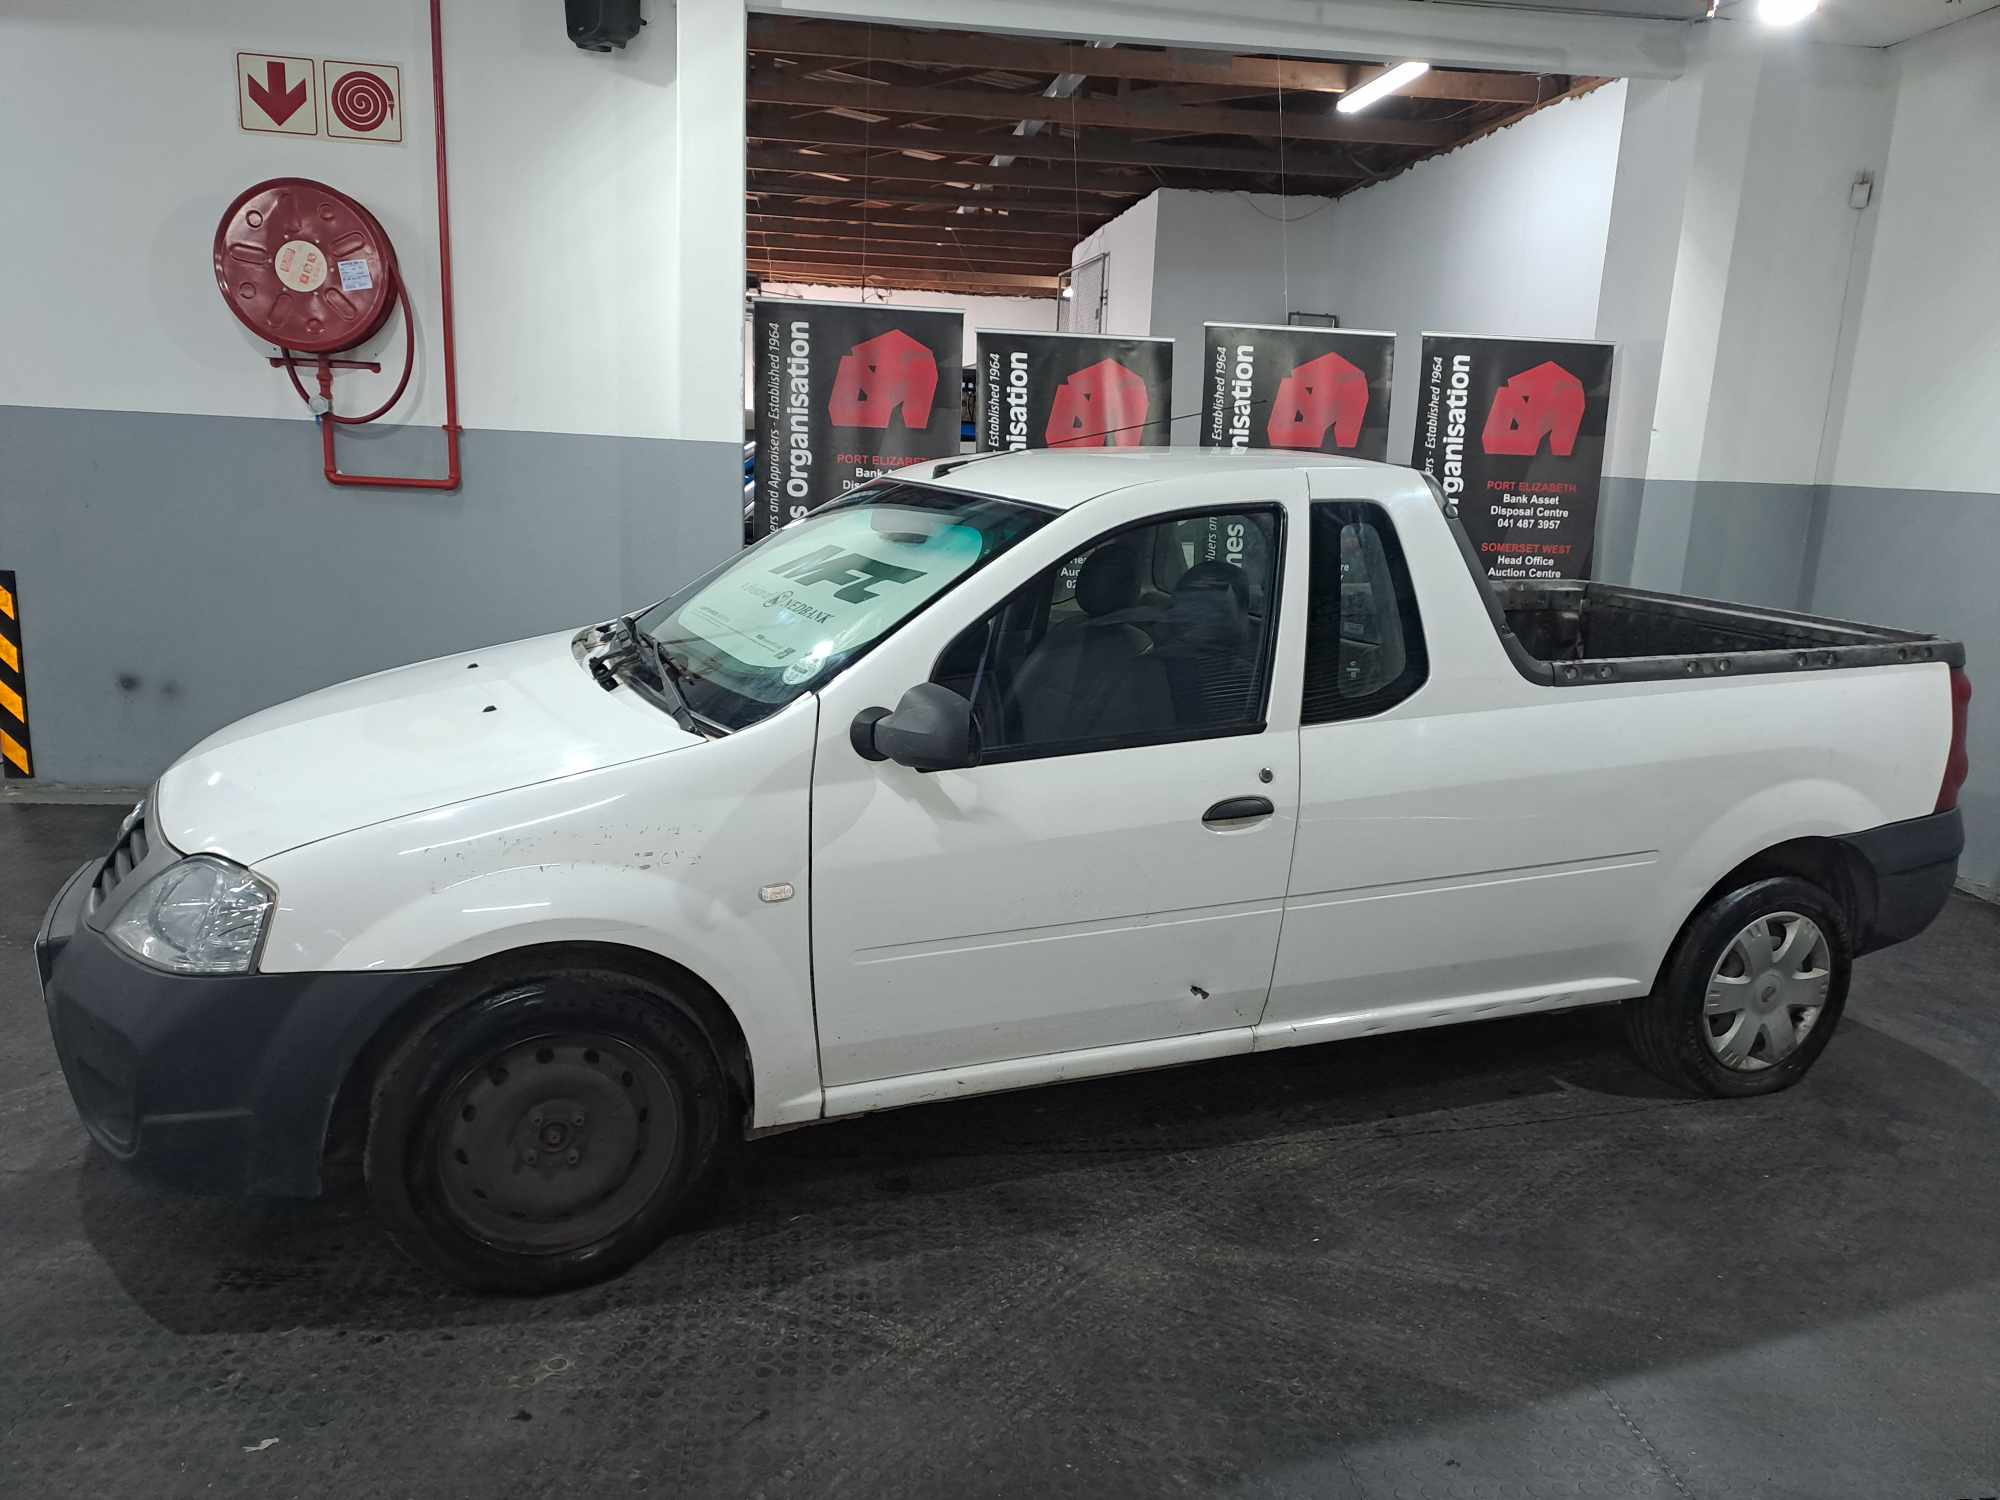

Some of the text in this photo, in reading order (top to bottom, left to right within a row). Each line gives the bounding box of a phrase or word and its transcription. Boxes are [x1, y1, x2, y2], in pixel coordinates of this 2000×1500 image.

[768, 322, 780, 351] 1964
[989, 353, 1000, 380] 1964
[1216, 346, 1226, 376] 1964
[1432, 356, 1443, 384] 1964
[768, 353, 780, 419] Established
[787, 321, 812, 497] Organisation
[988, 383, 1000, 447] Established
[1212, 376, 1225, 440] Established
[1425, 386, 1441, 449] Established
[768, 429, 781, 488] Appraisers
[837, 454, 869, 465] PORT
[855, 467, 882, 478] Bank
[1487, 480, 1577, 494] PORT ELIZABETH
[1503, 493, 1559, 505] Bank Asset
[768, 490, 779, 512] and
[1490, 505, 1569, 518] Disposal Centre
[1497, 518, 1561, 529] 041 487 3957
[1481, 542, 1573, 554] SOMERSET WEST
[1487, 567, 1561, 578] Auction Centre
[1497, 555, 1554, 566] Head Office
